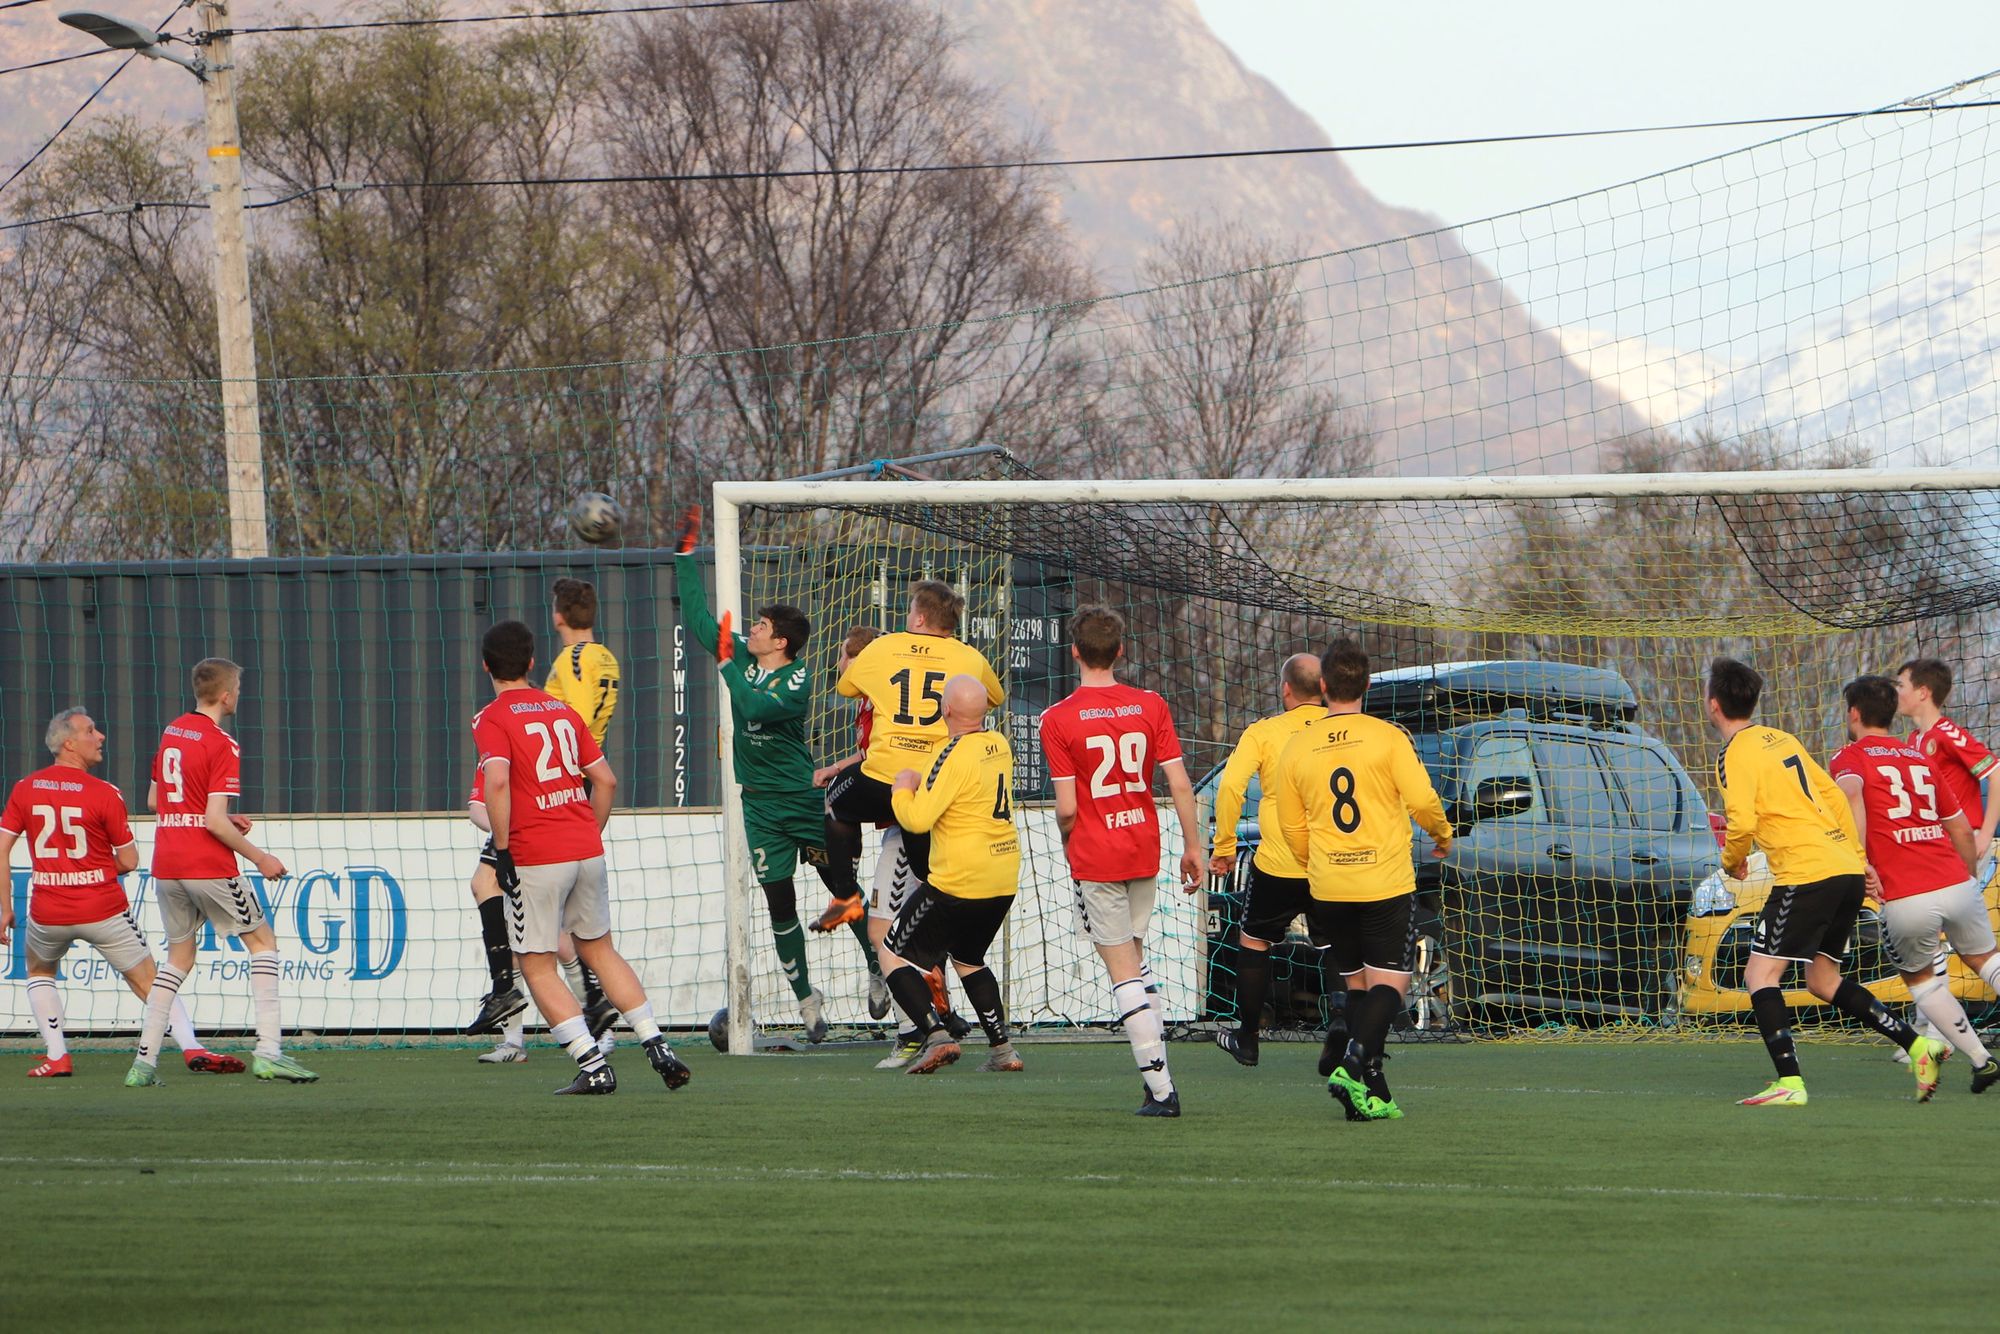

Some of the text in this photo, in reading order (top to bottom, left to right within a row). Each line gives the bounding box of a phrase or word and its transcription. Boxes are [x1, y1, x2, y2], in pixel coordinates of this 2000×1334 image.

[889, 668, 946, 726] 15
[1080, 704, 1142, 720] REMA 1000
[163, 747, 184, 803] 9
[524, 718, 580, 783] 20
[1085, 731, 1147, 799] 29
[32, 779, 84, 792] REMA 1000
[1329, 766, 1362, 835] 8
[1876, 764, 1939, 822] 35
[32, 804, 88, 860] 25
